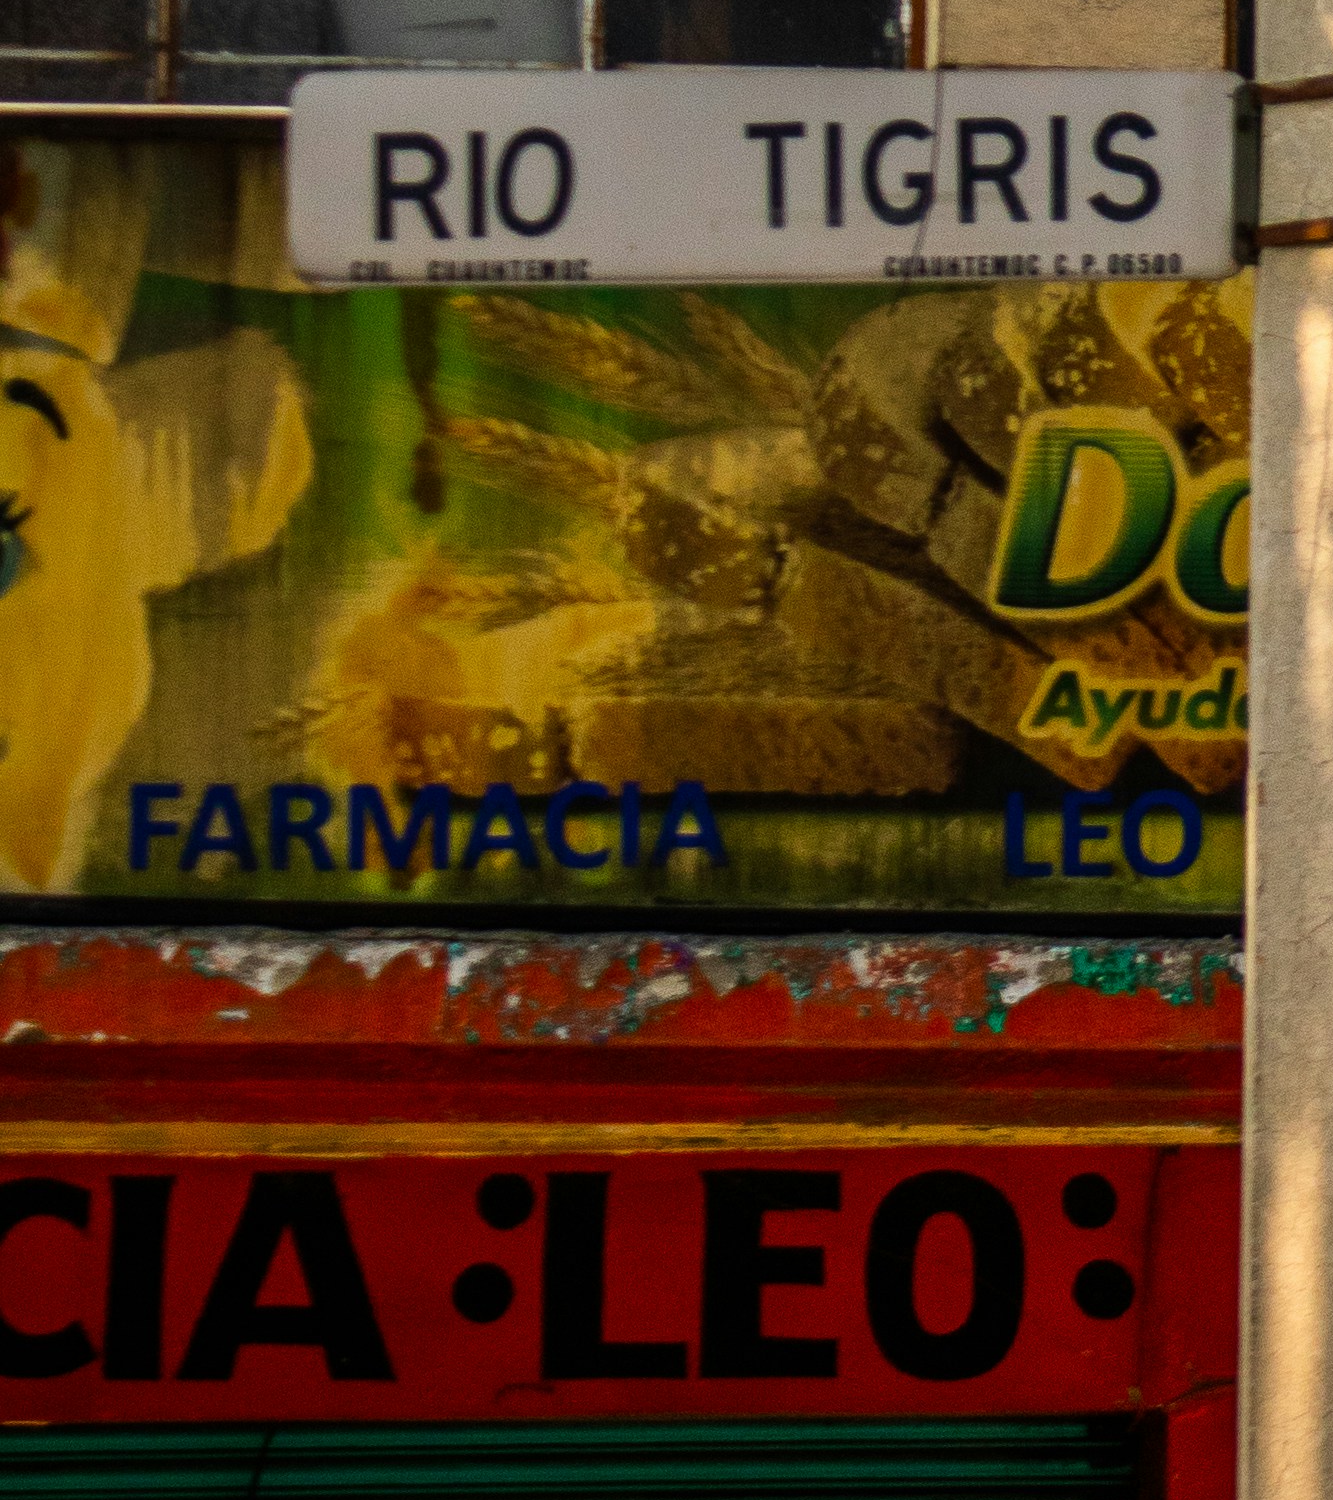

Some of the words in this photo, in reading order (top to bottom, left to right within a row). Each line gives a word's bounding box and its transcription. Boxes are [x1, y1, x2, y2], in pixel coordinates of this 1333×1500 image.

[373, 127, 577, 241] RIO
[745, 112, 1165, 228] TIGRIS
[127, 778, 731, 873] FARMACIA
[1003, 790, 1204, 880] LEO
